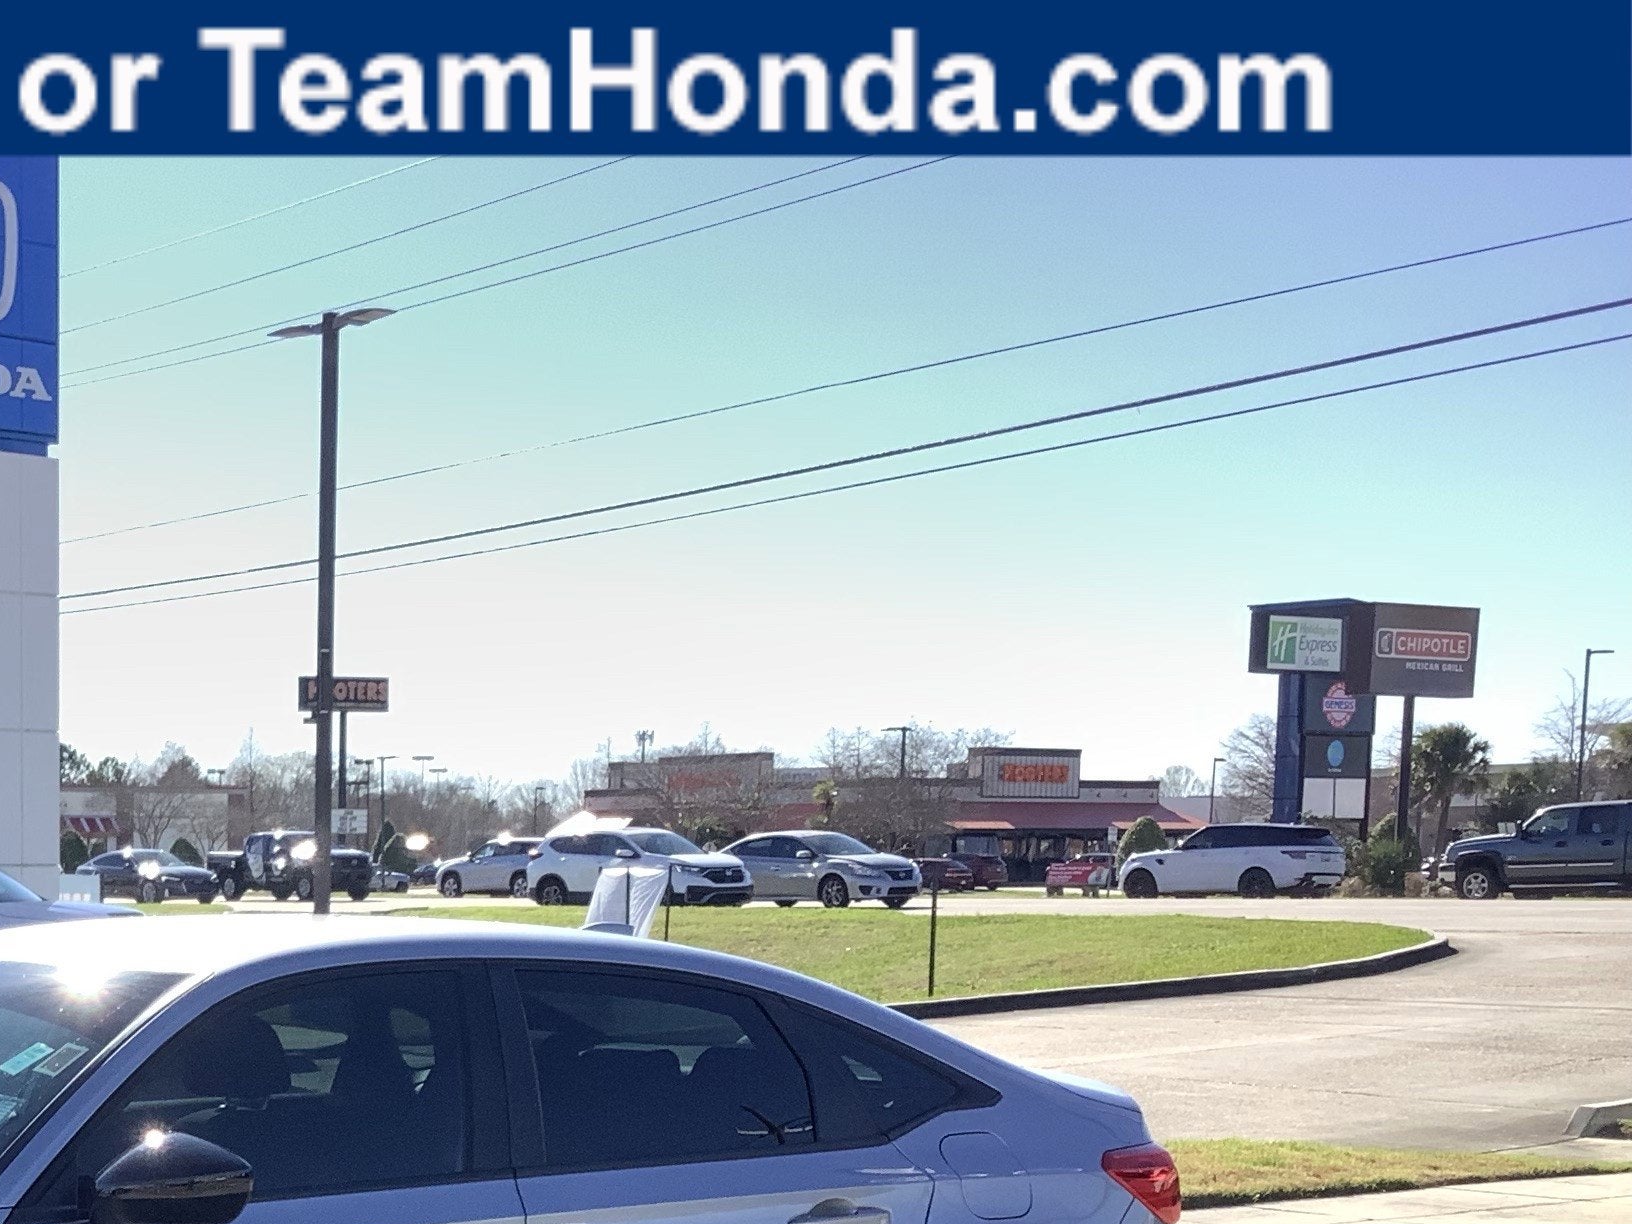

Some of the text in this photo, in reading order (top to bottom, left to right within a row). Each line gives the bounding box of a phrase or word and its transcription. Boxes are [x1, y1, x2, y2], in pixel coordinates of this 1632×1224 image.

[1299, 635, 1338, 653] Express
[1397, 636, 1467, 654] CHIPOTLE
[1406, 661, 1465, 673] MEXICAN GRILL
[308, 680, 387, 701] HOTERS
